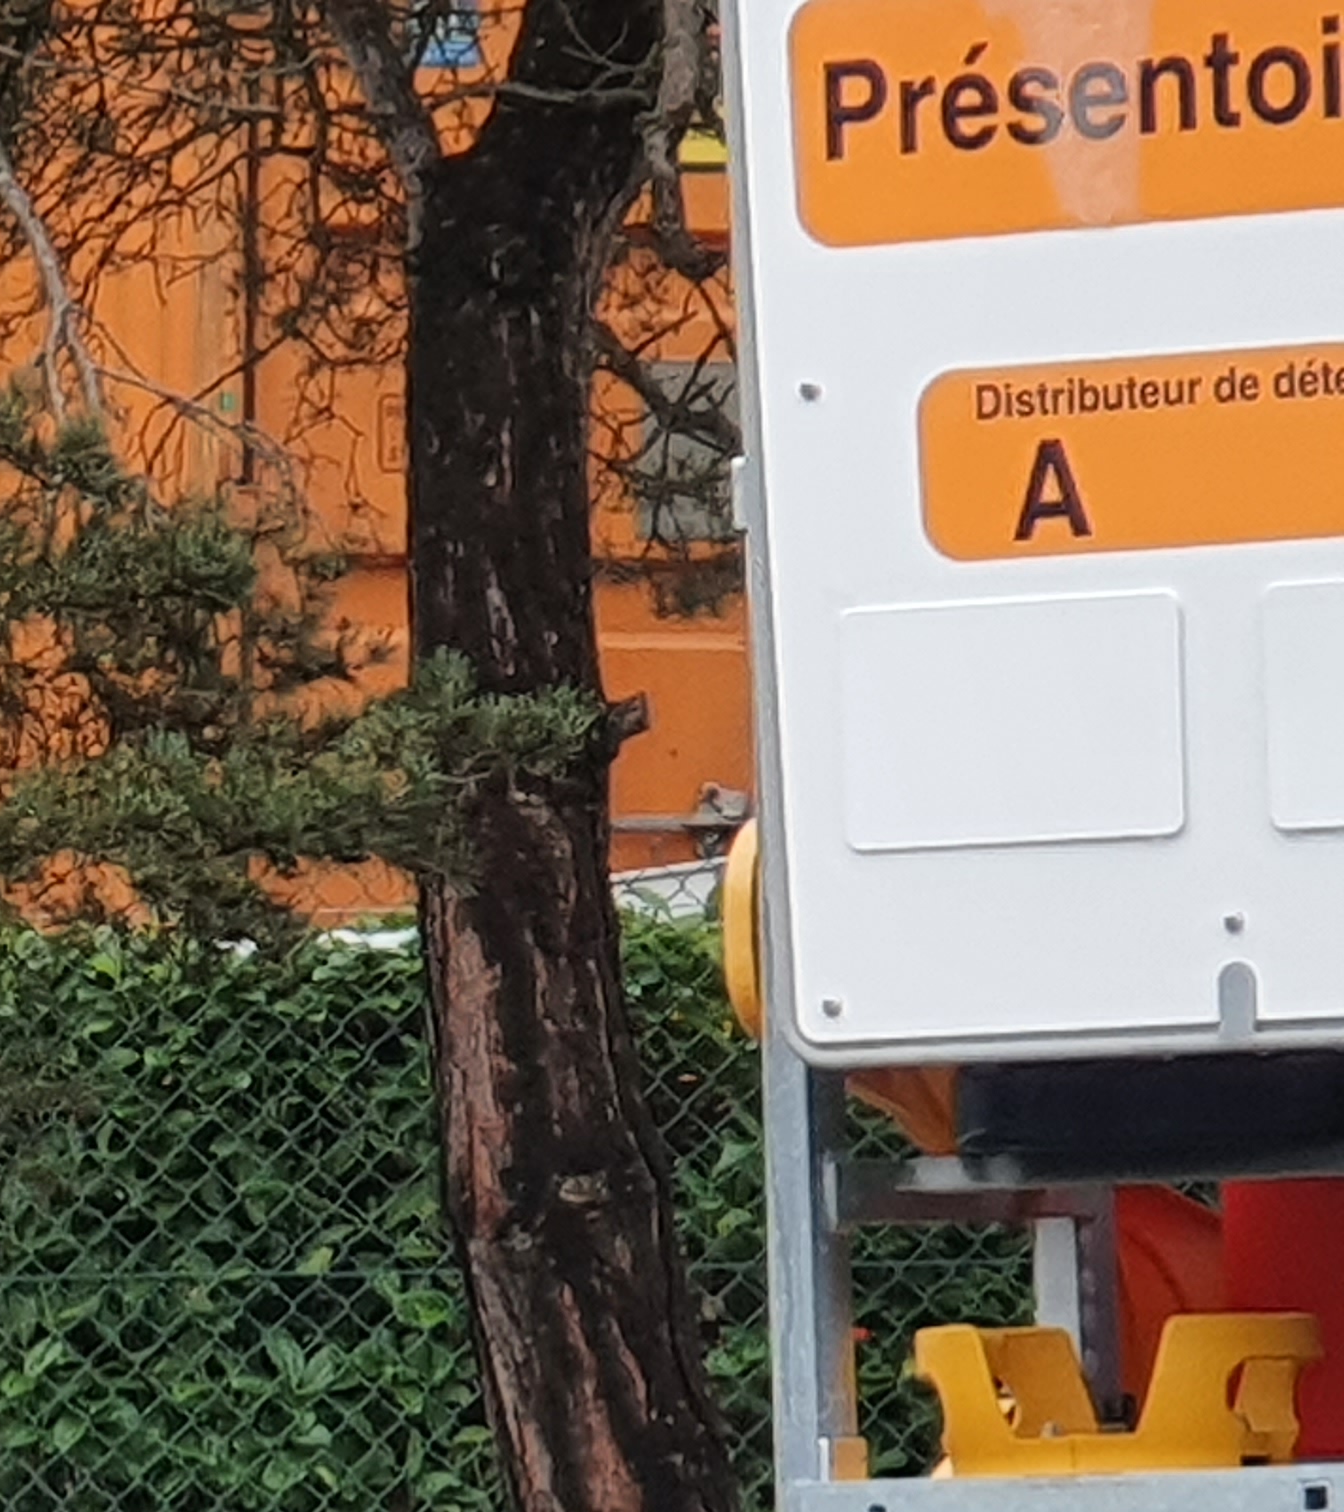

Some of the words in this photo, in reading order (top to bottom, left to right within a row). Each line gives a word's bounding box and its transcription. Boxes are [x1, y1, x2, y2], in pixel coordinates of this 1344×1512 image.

[823, 15, 1341, 162] Présentoi
[976, 376, 1203, 420] Distributeur
[1214, 367, 1259, 404] de
[1014, 438, 1092, 541] A
